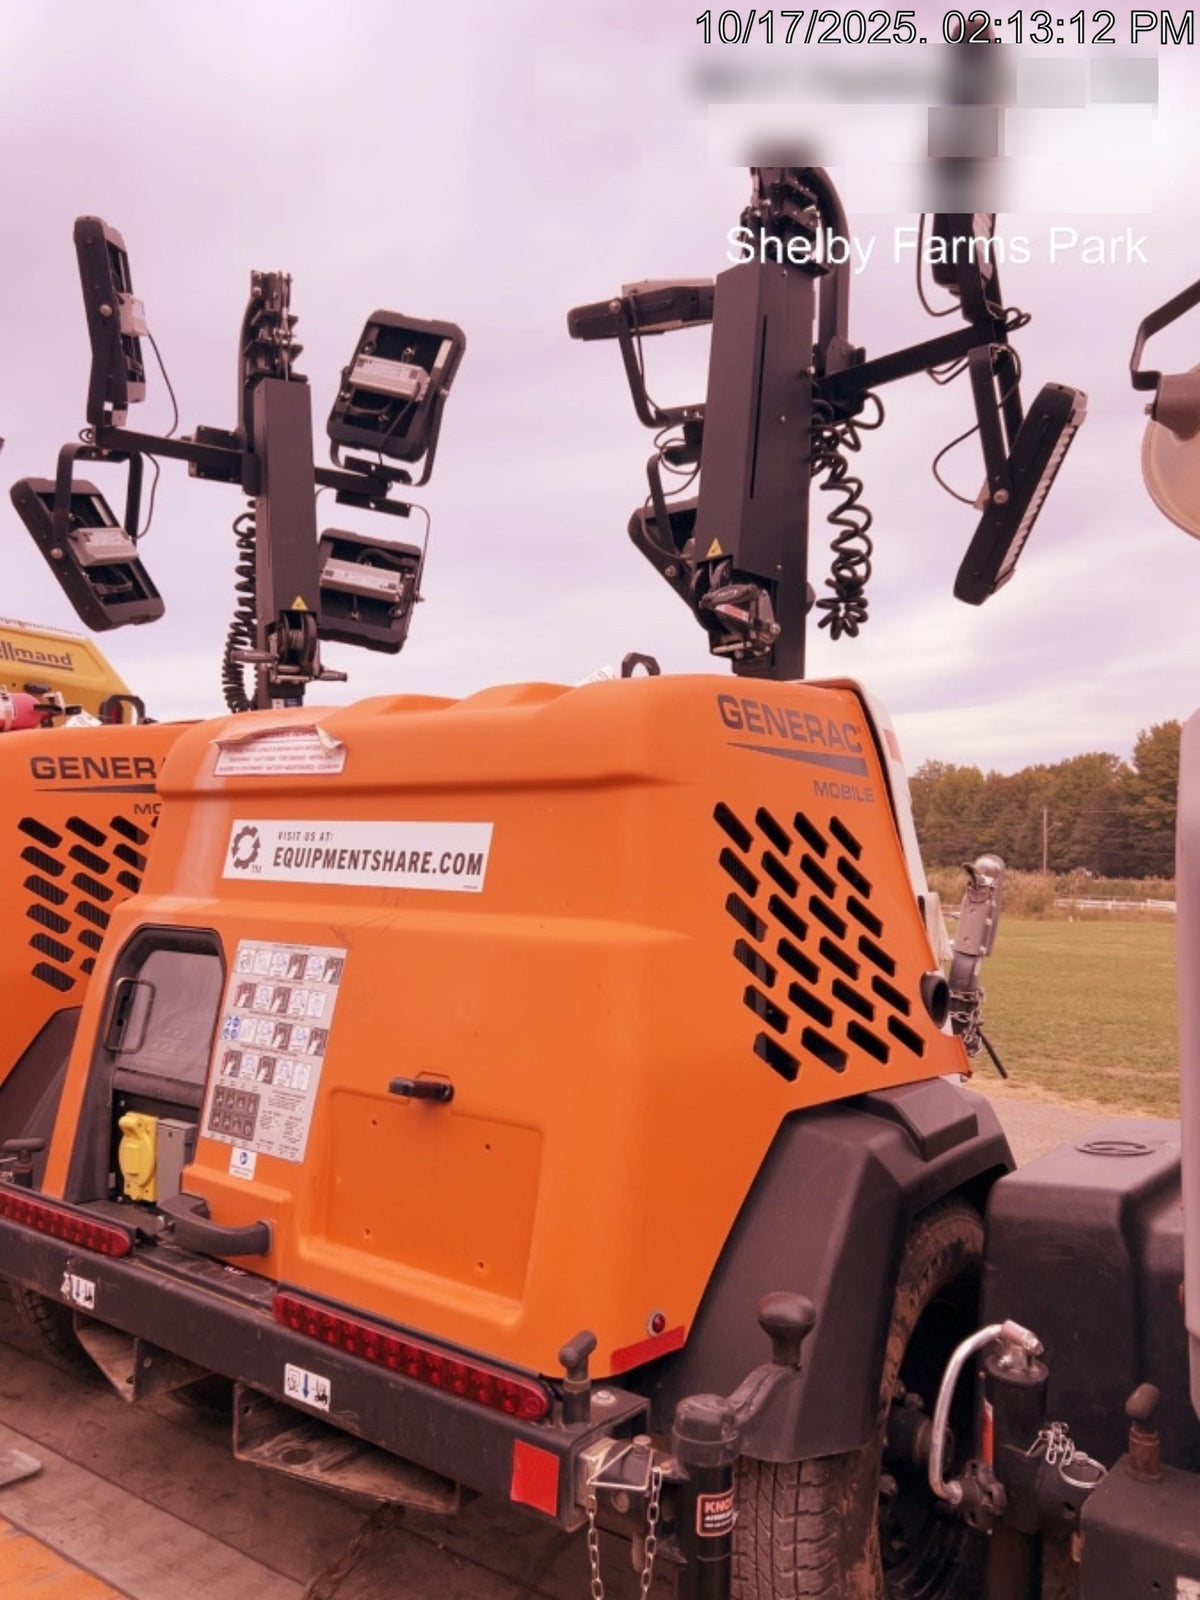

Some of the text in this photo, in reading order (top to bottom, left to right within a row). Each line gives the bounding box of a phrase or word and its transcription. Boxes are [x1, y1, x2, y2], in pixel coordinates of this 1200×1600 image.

[717, 693, 863, 753] GENERAC
[813, 780, 875, 802] MOBILE
[278, 831, 334, 842] VISIT US AT:
[273, 846, 484, 876] EQUIPMENTSHARE.COM
